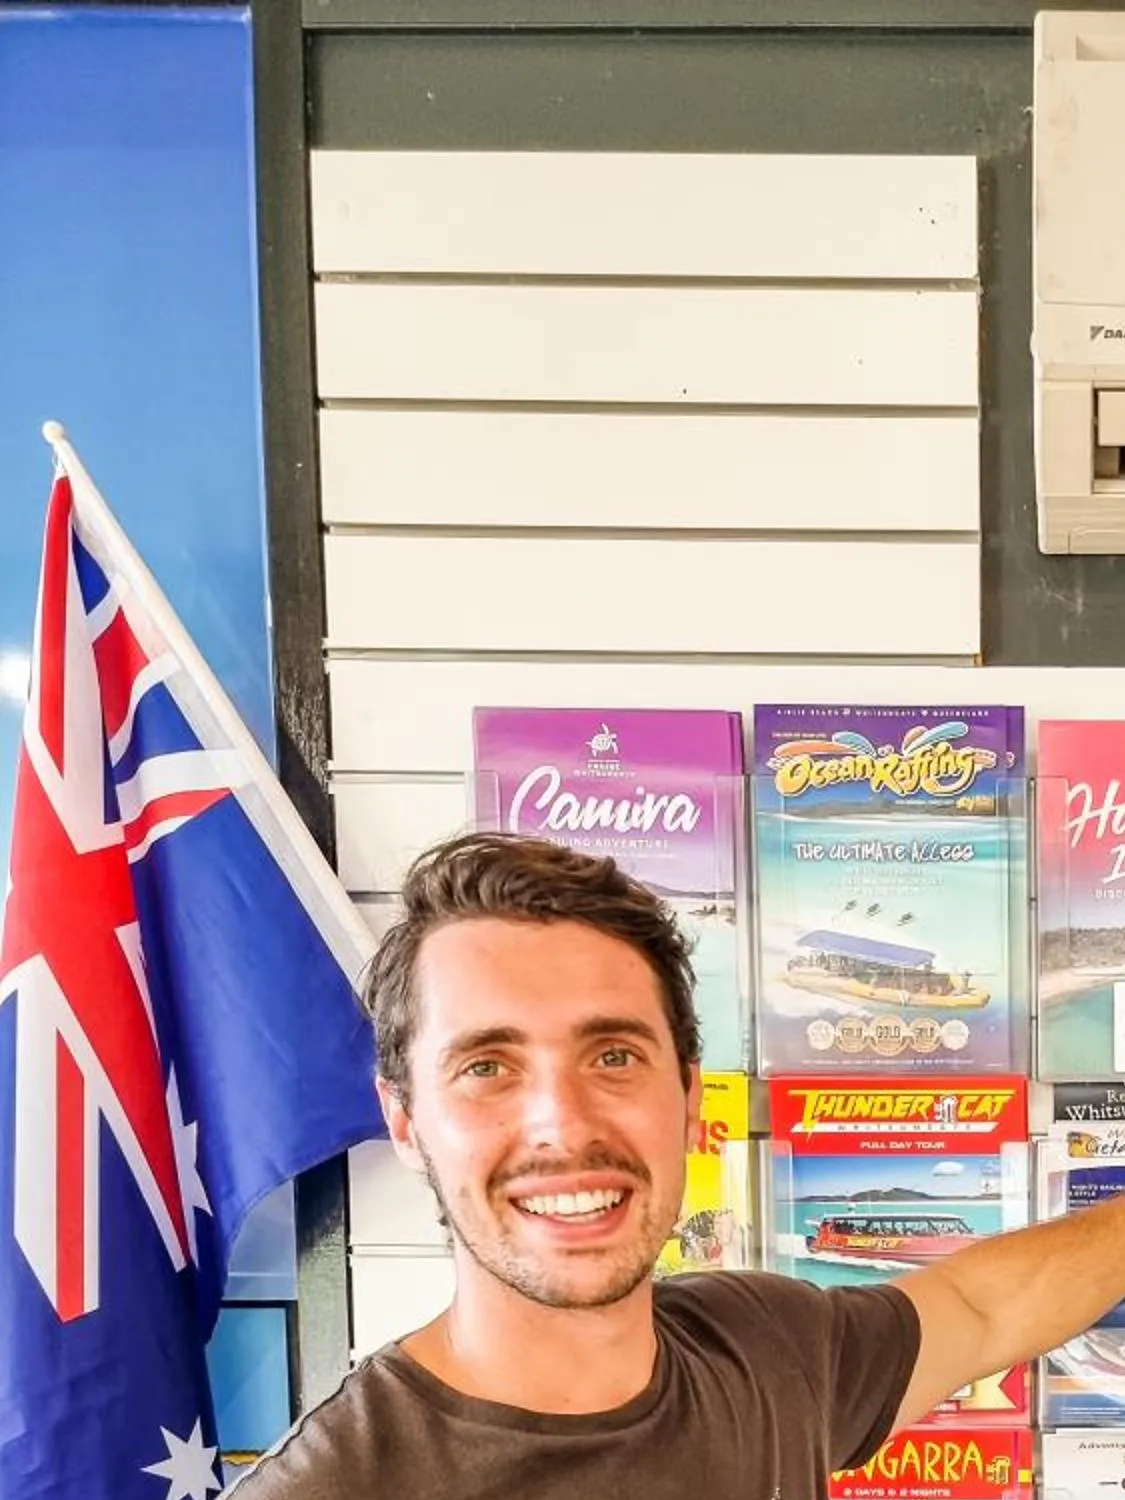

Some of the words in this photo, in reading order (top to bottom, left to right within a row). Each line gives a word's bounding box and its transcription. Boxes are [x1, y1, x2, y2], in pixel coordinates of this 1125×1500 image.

[776, 756, 876, 796] Ocean
[872, 742, 982, 796] Rafting
[509, 765, 702, 834] Camira
[790, 1089, 934, 1124] THUNDER
[957, 1089, 1014, 1121] CAT
[861, 1141, 887, 1150] FULL
[889, 1141, 913, 1150] DAY
[915, 1141, 946, 1150] TOUR
[910, 1487, 951, 1497] NIGHTS
